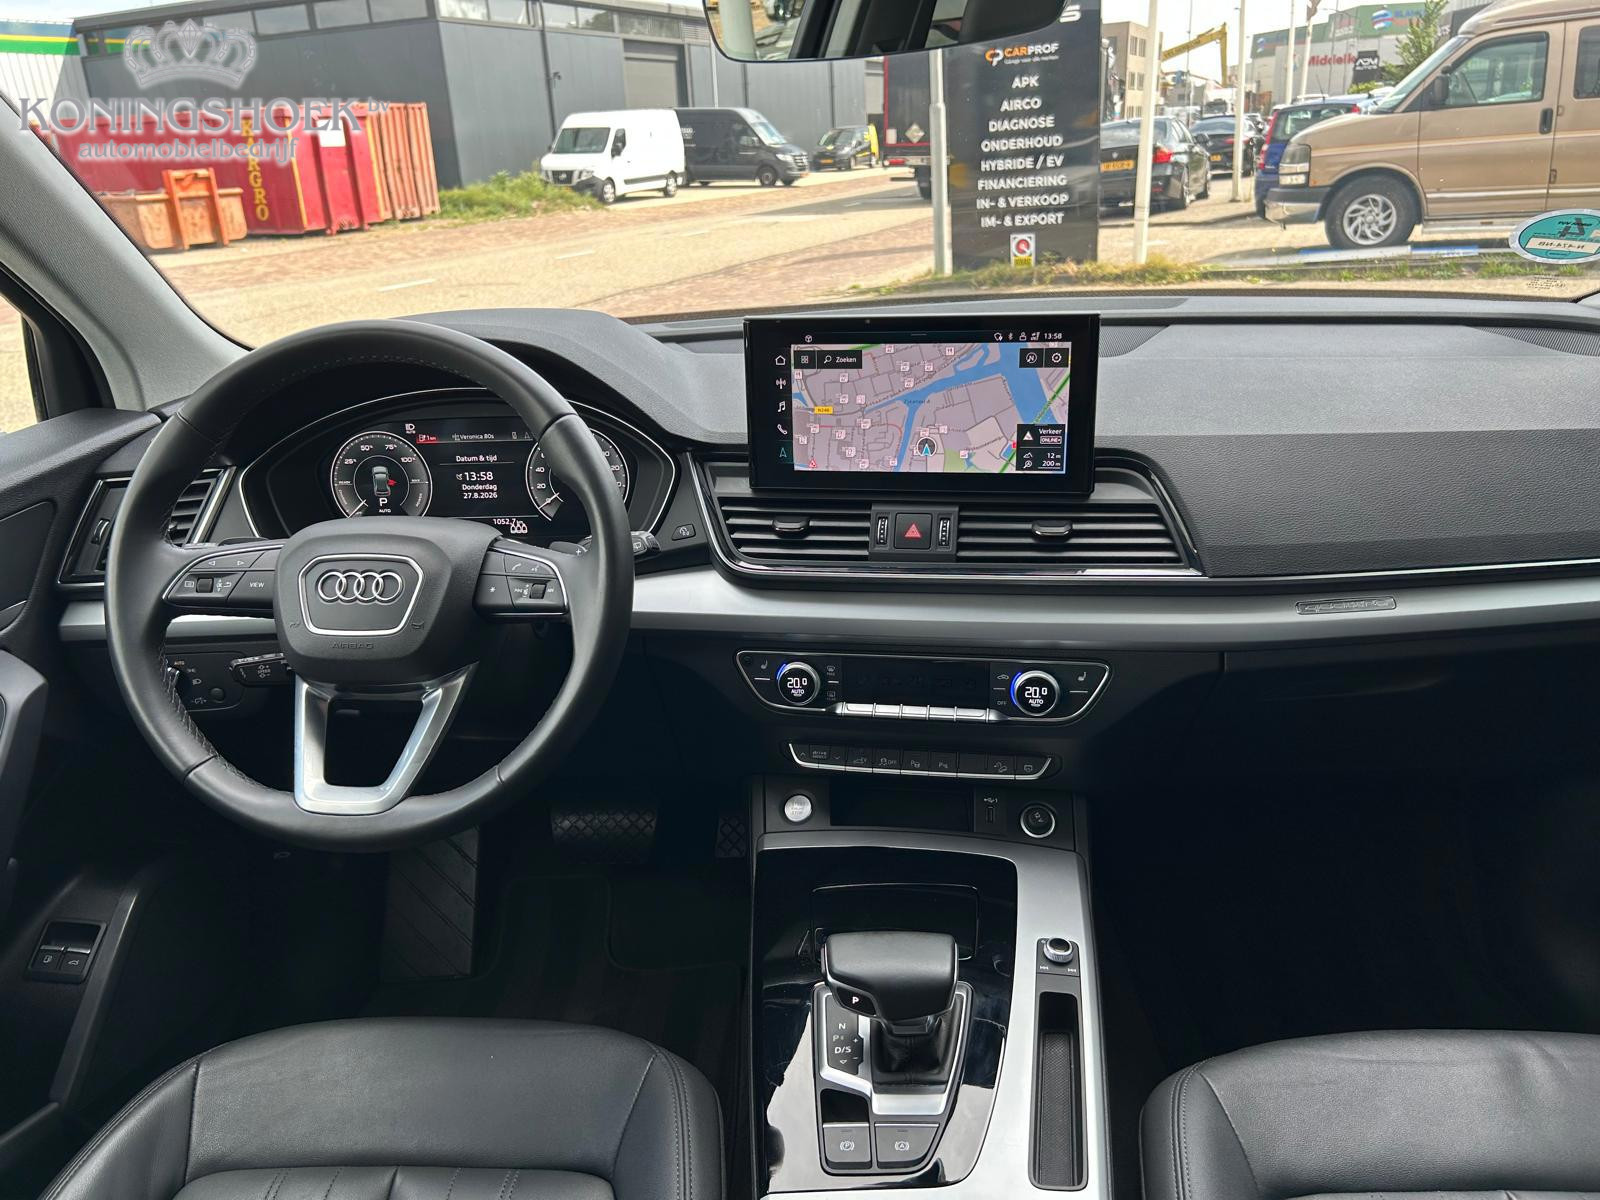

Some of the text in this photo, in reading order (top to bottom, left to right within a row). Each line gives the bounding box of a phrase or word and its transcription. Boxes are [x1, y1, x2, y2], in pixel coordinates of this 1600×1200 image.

[1004, 43, 1059, 57] CARPROF
[1012, 75, 1040, 89] APK
[1000, 97, 1042, 112] AIRCO
[988, 115, 1056, 132] DIAGNOSE
[980, 135, 1064, 153] ONDERHOUD
[981, 157, 1034, 172] HYBRIDE
[1046, 154, 1065, 168] EV
[977, 175, 1068, 191] FINANCIERING
[976, 192, 1070, 210] IN- & VERKOOP
[980, 211, 1065, 228] IM- & EXPORT
[1044, 332, 1063, 340] 13:58
[486, 454, 498, 463] tijd
[464, 471, 494, 481] 13:58
[462, 483, 498, 491] Donderdag
[379, 497, 388, 507] P
[852, 996, 860, 1005] P
[834, 1046, 852, 1054] D/S
